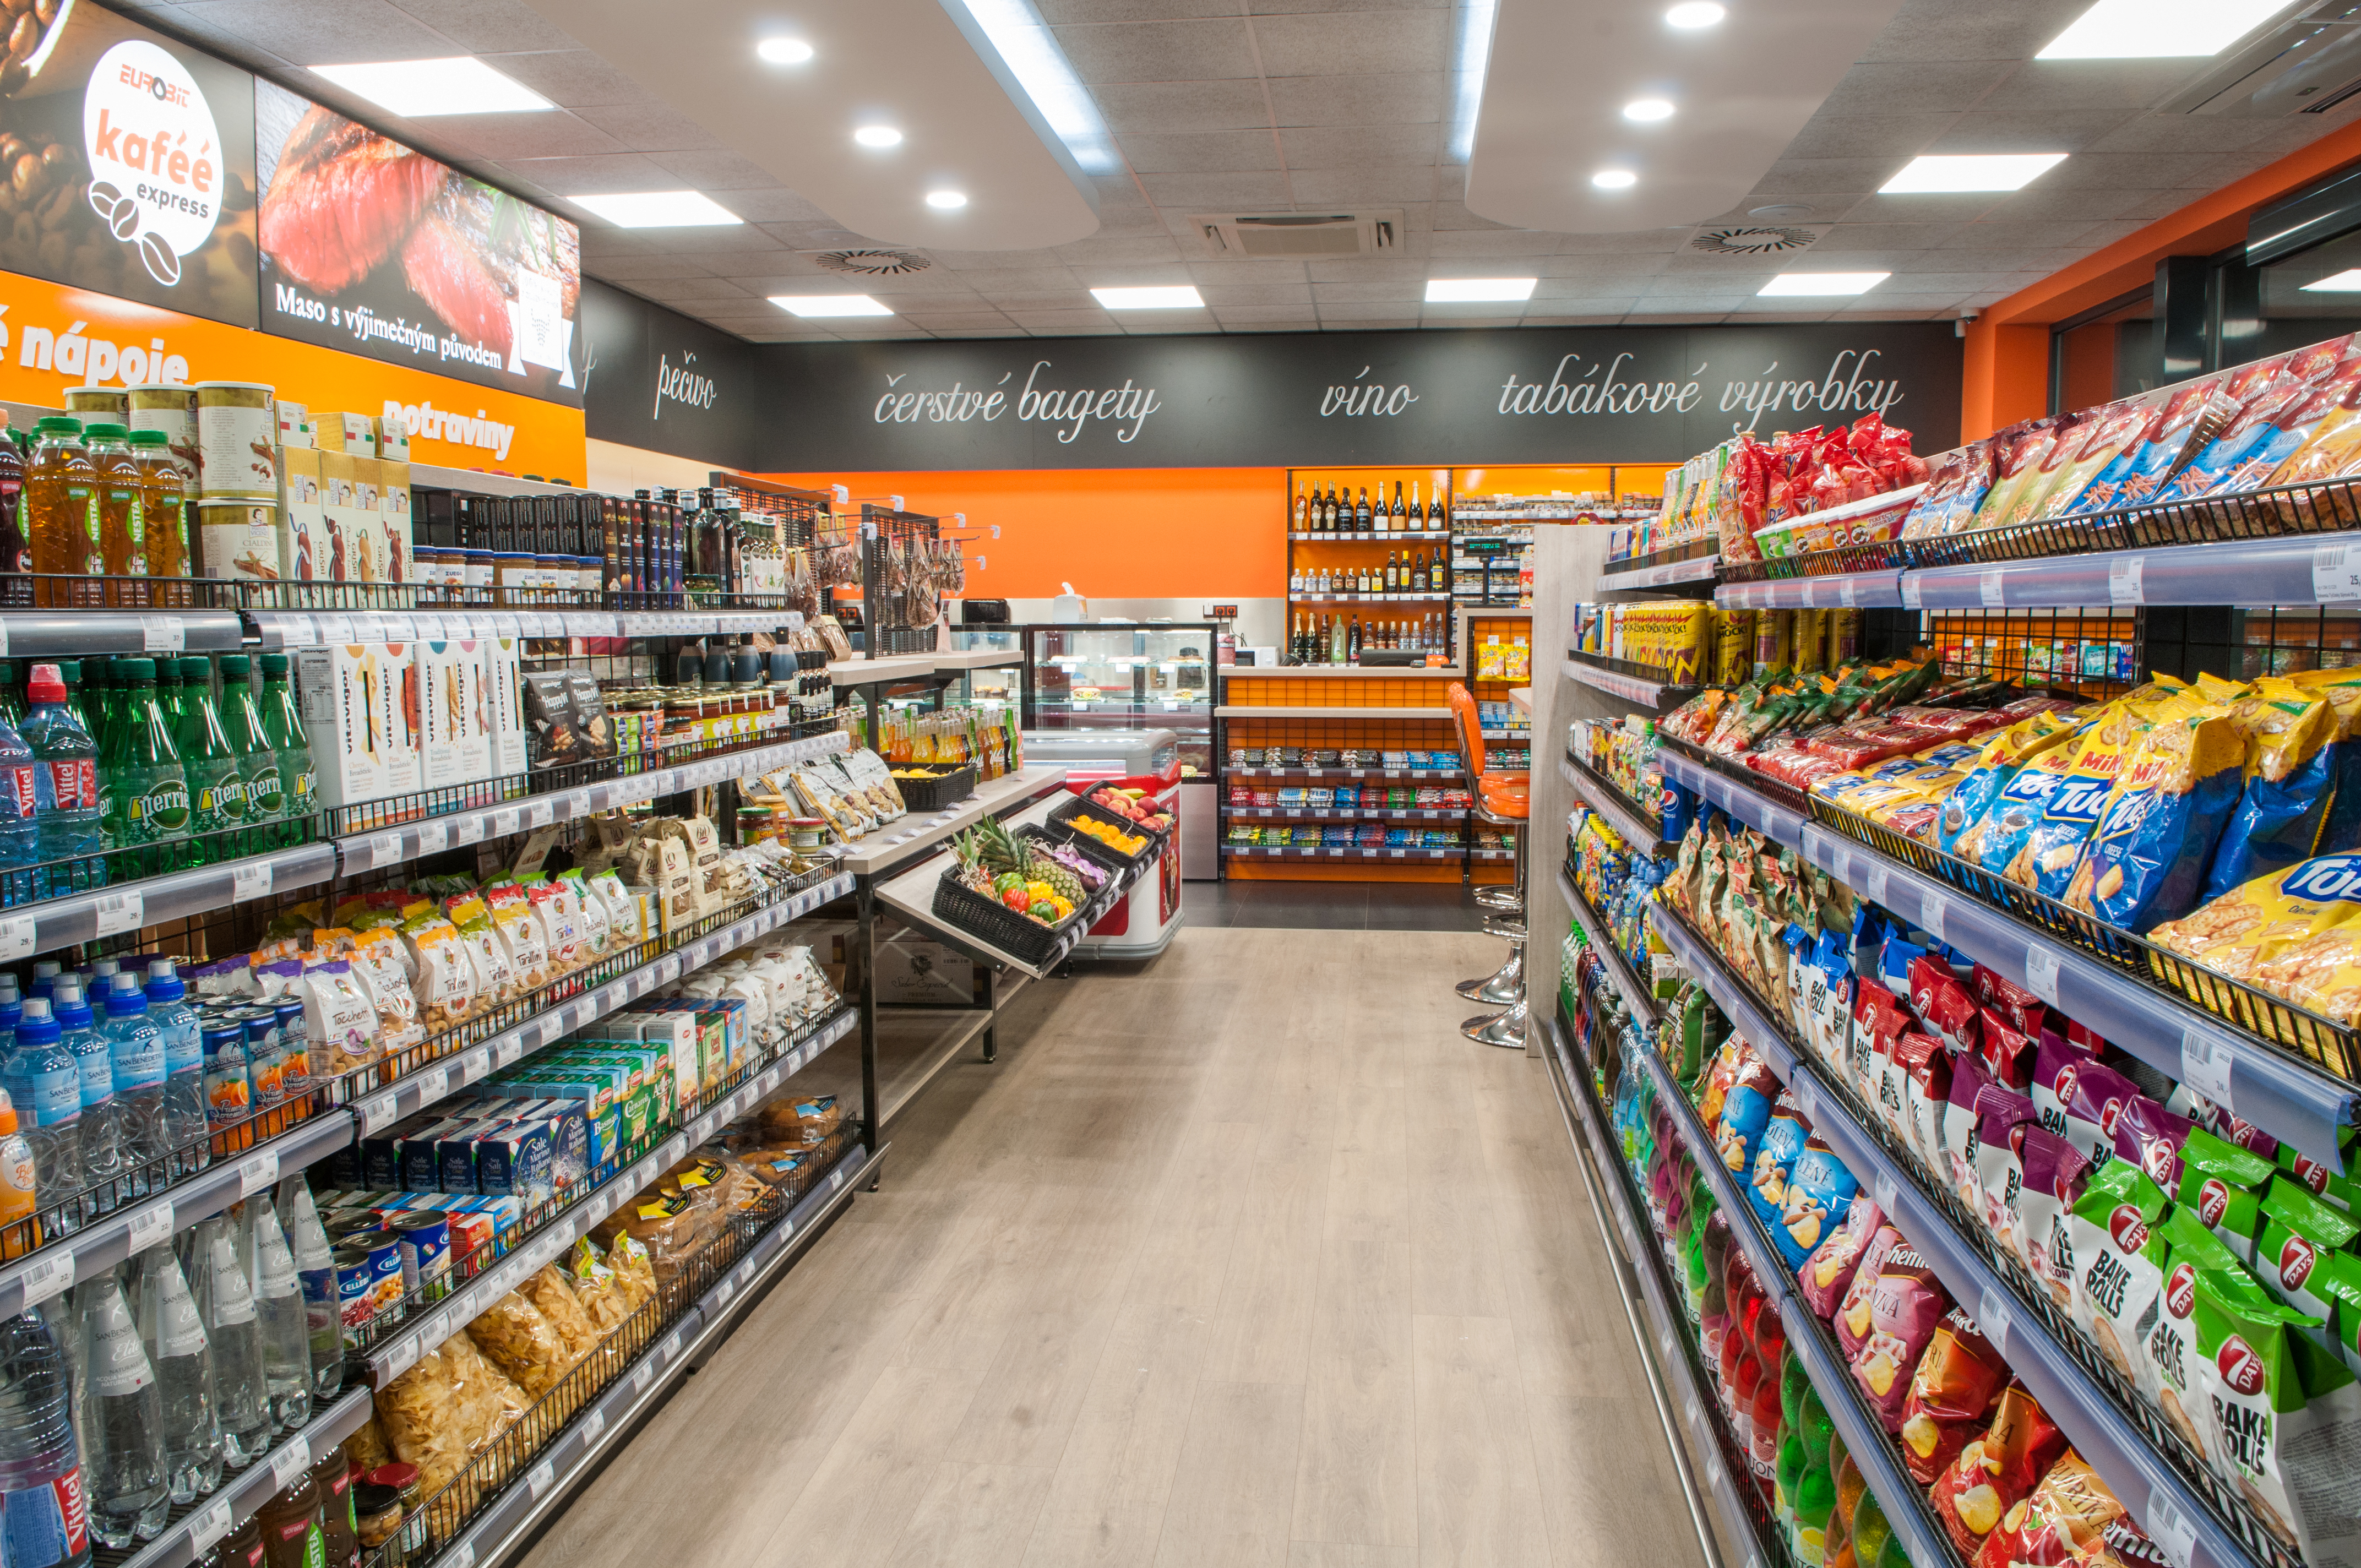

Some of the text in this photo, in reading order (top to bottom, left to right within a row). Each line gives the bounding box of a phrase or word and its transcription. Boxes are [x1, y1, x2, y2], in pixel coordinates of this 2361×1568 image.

[95, 108, 213, 193] kaféé
[137, 181, 209, 219] express
[275, 283, 502, 370] Maso s výjimečným původem
[654, 350, 717, 420] pečivo
[1320, 366, 1419, 416] víno
[1498, 350, 1905, 435] tabákové výrobky
[874, 361, 1162, 444] čerstvé bagety
[383, 400, 514, 461] potraviny
[89, 498, 100, 541] NESTEA
[132, 500, 143, 542] NESTEA
[1868, 511, 1893, 524] PERFECT
[382, 662, 393, 749] vitavigor
[426, 660, 434, 743] vitavigor
[457, 658, 466, 738] vitavigor
[497, 655, 506, 732] vitavigor
[341, 664, 353, 755] vitavigor
[22, 770, 35, 812] Vittel
[59, 763, 77, 807] Vittel
[2056, 823, 2080, 837] CHEESE
[2104, 843, 2124, 858] CHEESE
[129, 911, 142, 921] 29,-
[20, 938, 34, 947] 29,-
[516, 949, 542, 967] Tarallini
[332, 1007, 370, 1026] Tocchetti
[652, 1075, 673, 1099] Arborio
[2216, 1080, 2228, 1096] 24,-
[624, 1092, 650, 1118] Carnaroli
[568, 1124, 585, 1142] Marino
[569, 1115, 583, 1130] Sale
[594, 1111, 619, 1136] Basmati
[529, 1147, 550, 1166] Marino
[530, 1136, 547, 1155] Sale
[568, 1136, 586, 1151] Italiano
[488, 1162, 502, 1170] Salt
[530, 1158, 551, 1175] Italiano
[2156, 1153, 2174, 1182] DAYS
[2204, 1195, 2227, 1223] DAYS
[160, 1222, 173, 1232] 22,-
[2125, 1222, 2148, 1251] DAYS
[59, 1272, 73, 1283] 22,-
[346, 1275, 370, 1292] ELLEBI
[2093, 1248, 2132, 1296] BAKE
[2287, 1253, 2314, 1286] DAYS
[2085, 1268, 2124, 1319] ROLLS
[96, 1331, 110, 1341] SAN
[2151, 1337, 2187, 1391] ROLLS
[2222, 1344, 2263, 1390] 7 DAYS
[2212, 1392, 2267, 1448] BAKE
[2225, 1428, 2265, 1477] OLLS
[63, 1473, 85, 1544] Vittel
[283, 1523, 305, 1536] NOVINKA
[308, 1529, 320, 1568] ESTEA
